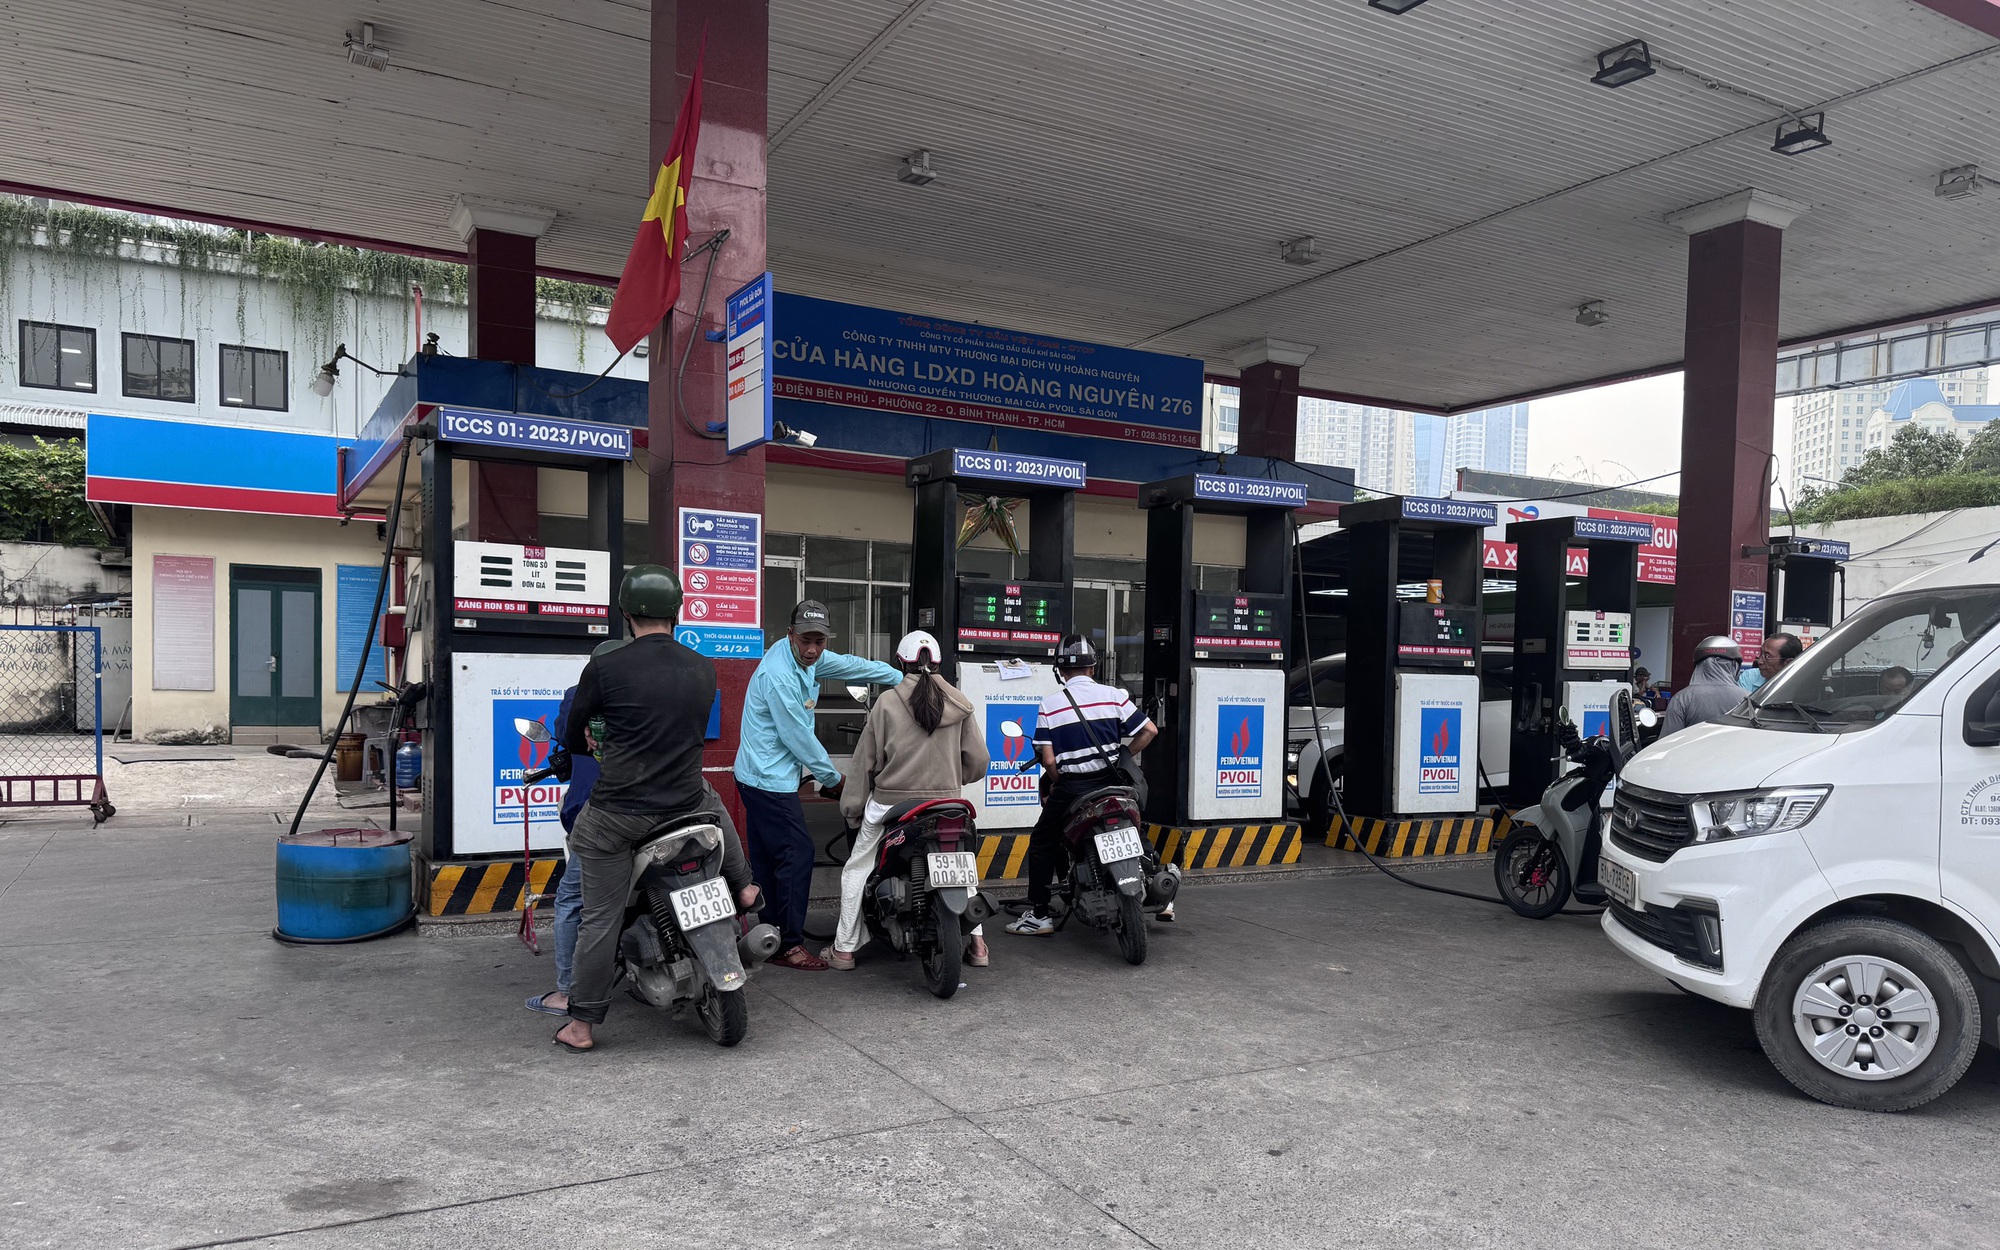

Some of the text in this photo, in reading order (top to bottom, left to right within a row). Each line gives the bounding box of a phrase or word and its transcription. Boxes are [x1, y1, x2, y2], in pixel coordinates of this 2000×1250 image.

[842, 330, 1140, 383] CÔNG TY TNHH MTV THƯƠNG MẠI DỊCH VỤ HOÀNG NGUYÊN
[772, 336, 1192, 415] CỬA HÀNG LDXD HOÀNG NGUYÊN 276
[786, 382, 813, 396] ĐIỆN
[816, 387, 843, 400] BIÊN
[846, 391, 868, 404] PHỦ
[878, 396, 922, 413] PHƯỜNG
[926, 404, 937, 413] 22
[946, 406, 956, 416] Q.
[960, 406, 983, 418] BÌNH
[986, 410, 1019, 423] THẠNH
[1027, 416, 1042, 426] TP.
[1044, 417, 1065, 428] HCM
[868, 378, 916, 394] NHƯỢNG
[960, 391, 1002, 404] THƯƠNG
[1004, 398, 1022, 408] MẠI
[1026, 398, 1046, 410] CỦA
[1048, 403, 1076, 414] PVOIL
[1079, 406, 1095, 416] SÀI
[1097, 408, 1118, 418] GÒN
[446, 416, 626, 450] TCCS 01: 2023/PVOIL
[1124, 428, 1196, 444] ĐT: 028.3512.1546
[958, 455, 1082, 480] TCCS 01: 2023/PVOIL
[1198, 479, 1304, 500] TCCS 01: 2023/PVOIL
[1405, 501, 1494, 519] TCCS 01: 2023/PVOIL
[1576, 520, 1650, 538] TCCS 01: 2023/PVOIL
[457, 600, 526, 611] XĂNG RON 95 III
[541, 604, 606, 616] XĂNG RON 95 III
[961, 629, 977, 637] XĂNG
[715, 644, 750, 653] 24/24
[503, 687, 512, 696] SỐ
[513, 686, 520, 696] VỀ
[532, 688, 552, 696] TRƯỚC
[1220, 756, 1259, 765] PETROVIETNAM
[1424, 756, 1457, 764] PETROVIETNAM
[1220, 771, 1258, 784] PVOIL
[1423, 769, 1456, 781] PVOIL
[990, 776, 1035, 791] PVOIL
[1960, 799, 1970, 816] CTY
[1966, 779, 1987, 798] TNHH
[521, 811, 538, 819] QYỀN
[1961, 817, 1978, 825] ĐT:
[1102, 842, 1140, 860] 038.93
[935, 855, 969, 869] 59-NA
[933, 870, 975, 885] 008.36
[680, 882, 720, 908] 60-B5
[680, 898, 732, 928] 349.90
